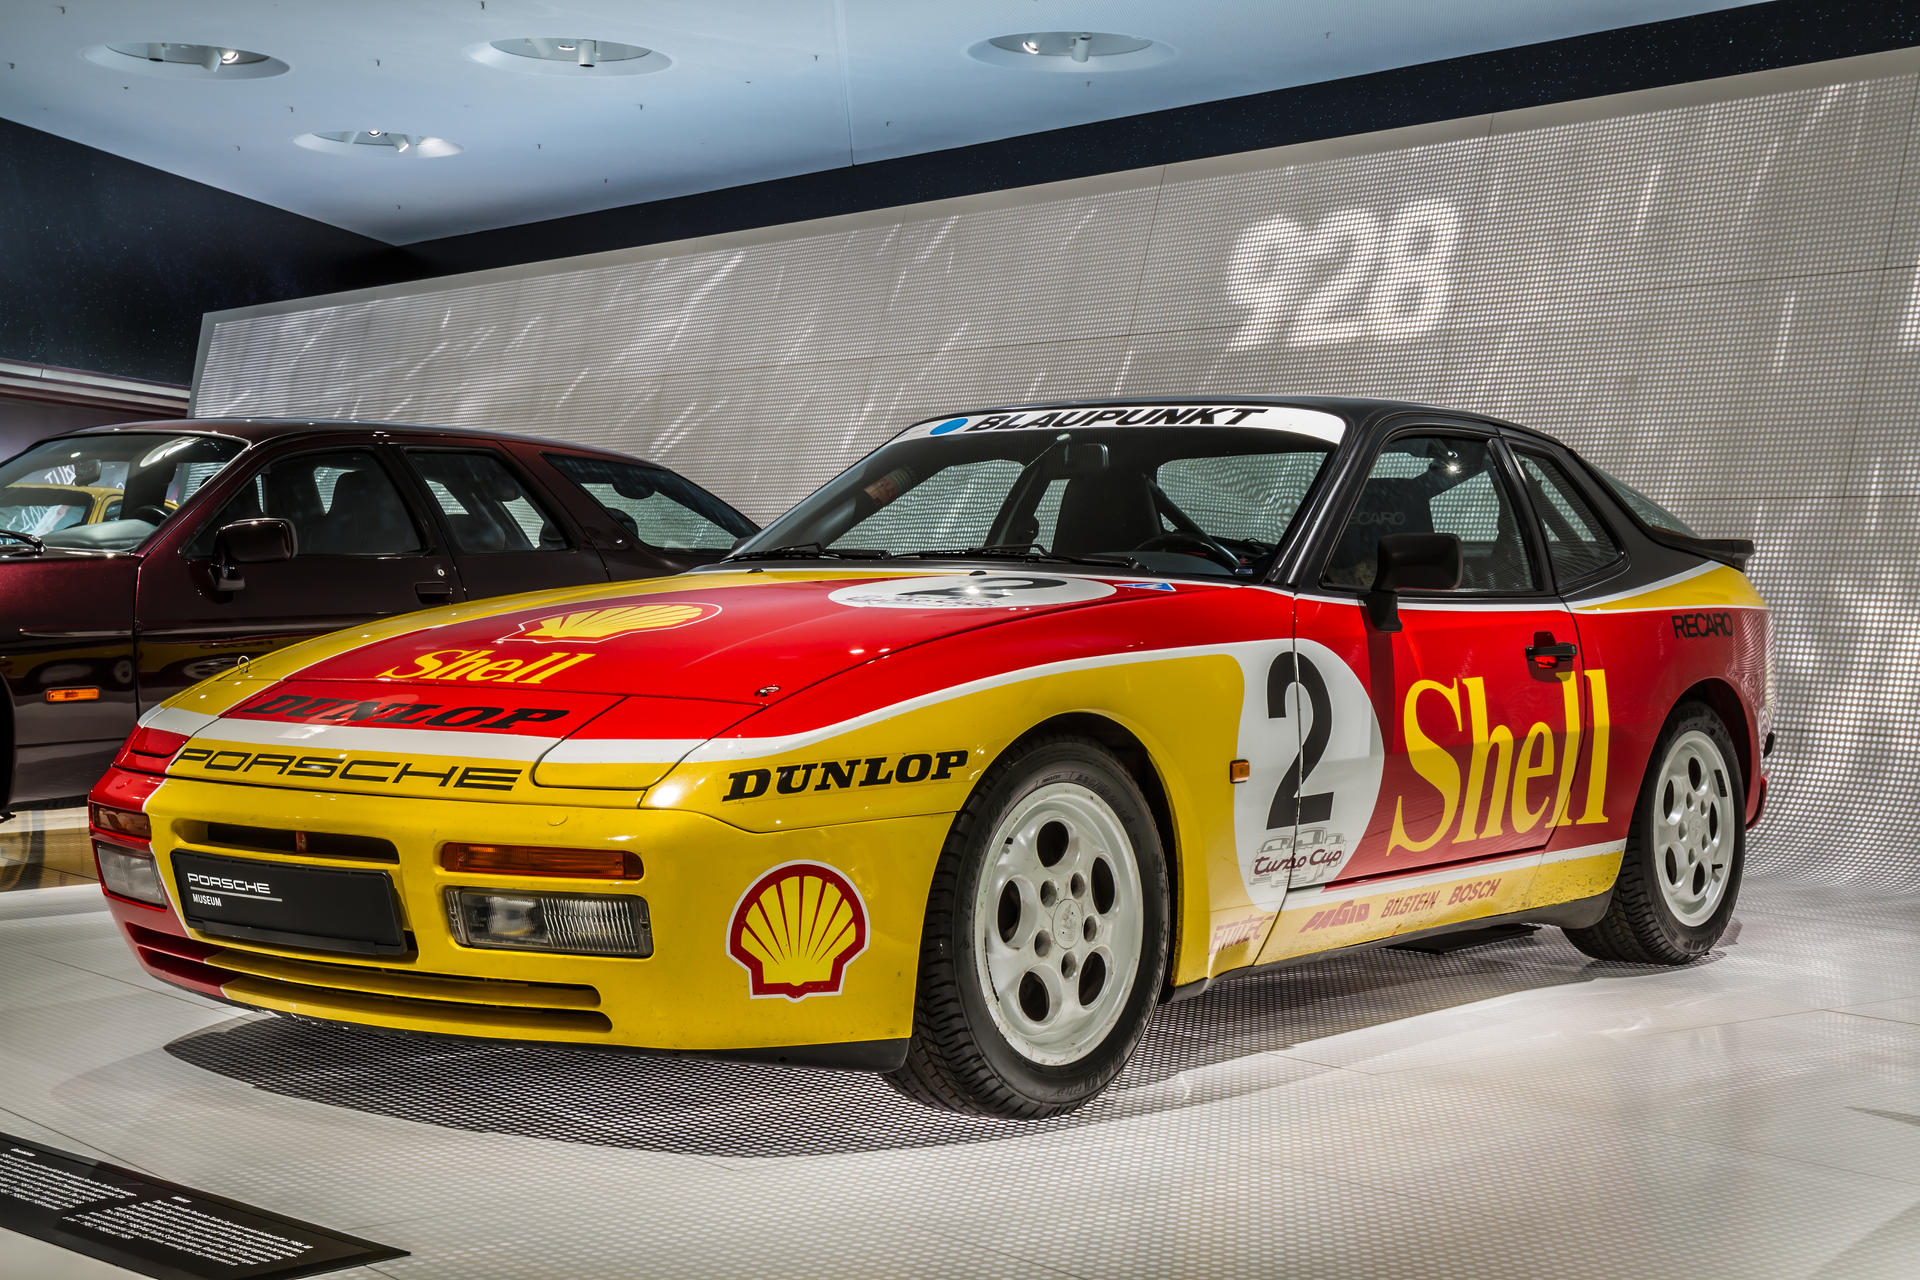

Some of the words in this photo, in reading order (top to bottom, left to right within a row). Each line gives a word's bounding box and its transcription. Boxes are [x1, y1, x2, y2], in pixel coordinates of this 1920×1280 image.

[1227, 199, 1459, 351] 928
[964, 408, 1269, 433] BLAUPUNKT
[1671, 612, 1734, 639] RECARO
[376, 650, 596, 684] Shell
[240, 694, 571, 730] DUNLOP
[1266, 651, 1334, 831] 2
[170, 748, 523, 792] PORSCHE
[722, 750, 969, 802] DUNLOP
[1386, 669, 1611, 857] Shell
[1309, 848, 1343, 868] Cup
[187, 872, 271, 894] PORSCHE
[192, 893, 223, 907] MUSEUM
[1380, 890, 1441, 919] BILSTEIN
[1447, 878, 1502, 906] BOSCH
